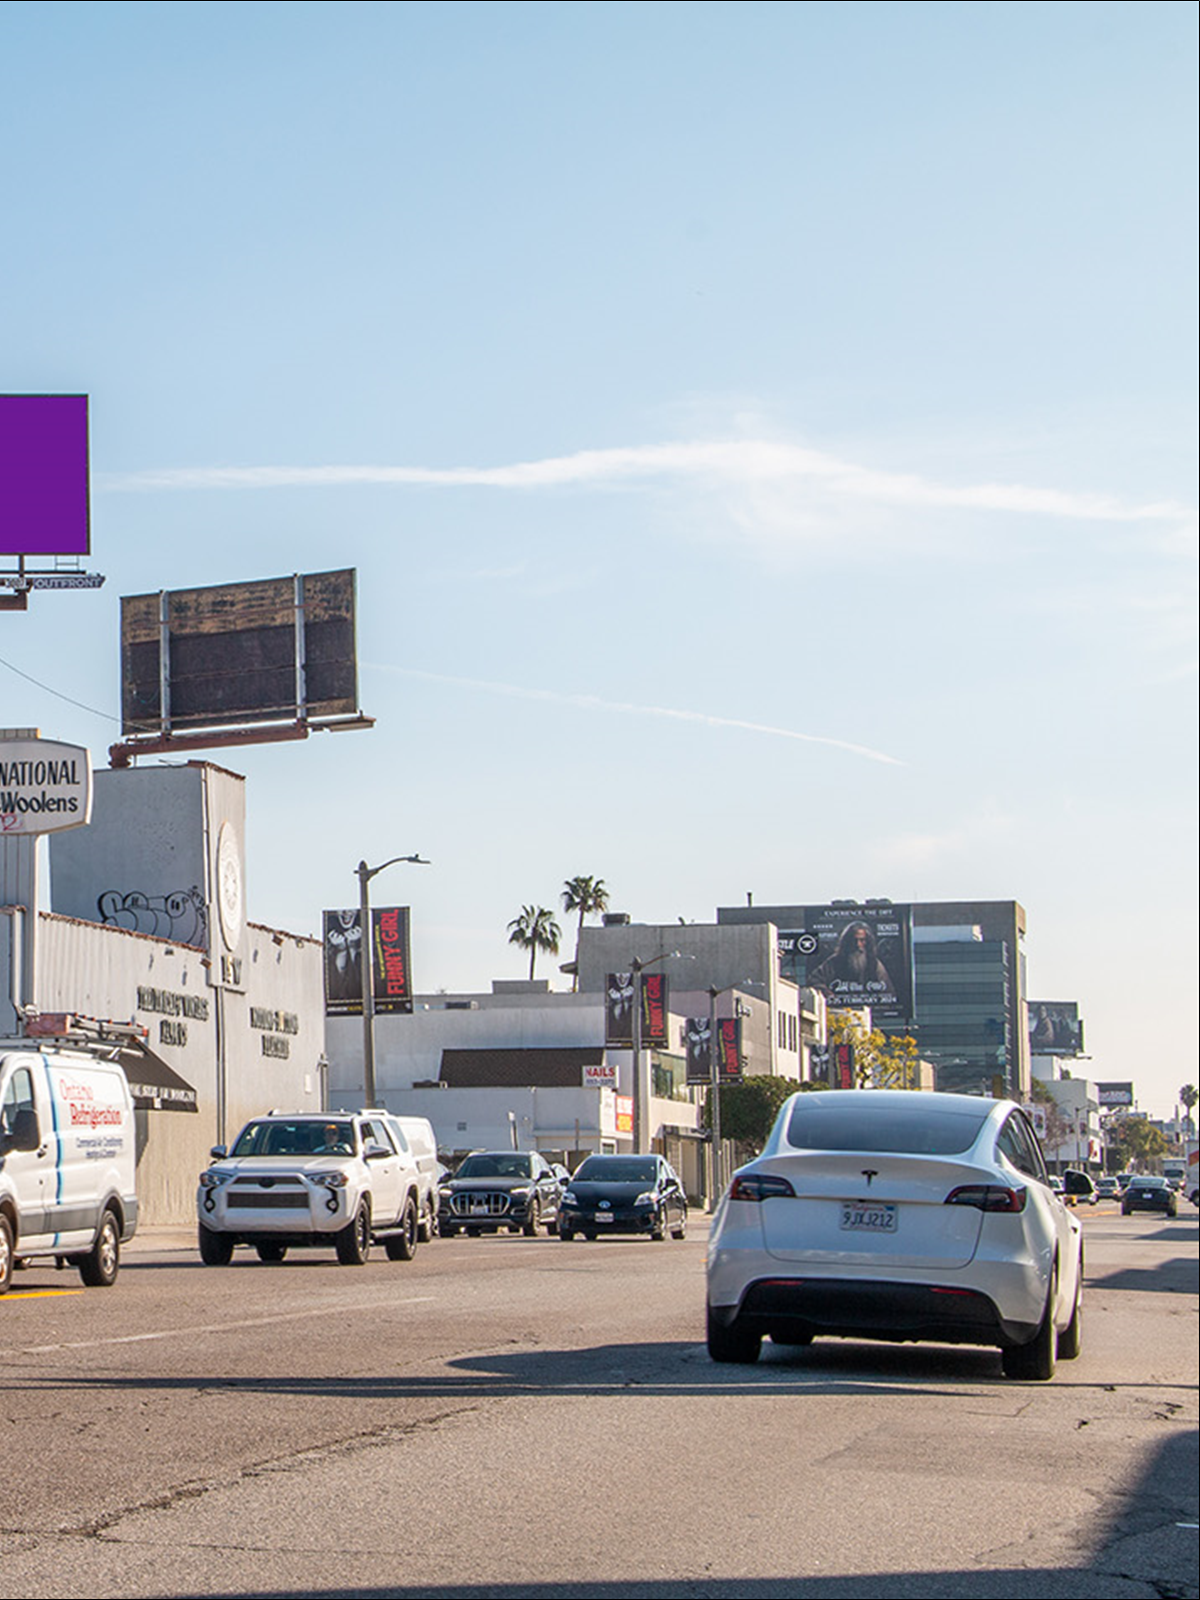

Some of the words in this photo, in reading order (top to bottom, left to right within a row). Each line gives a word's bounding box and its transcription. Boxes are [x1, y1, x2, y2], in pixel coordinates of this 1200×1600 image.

[35, 578, 102, 588] OUTFRONT
[380, 909, 399, 943] GIRL
[383, 945, 405, 995] FUNNY
[585, 1067, 616, 1078] NAILS
[69, 1102, 122, 1130] Refrigeration
